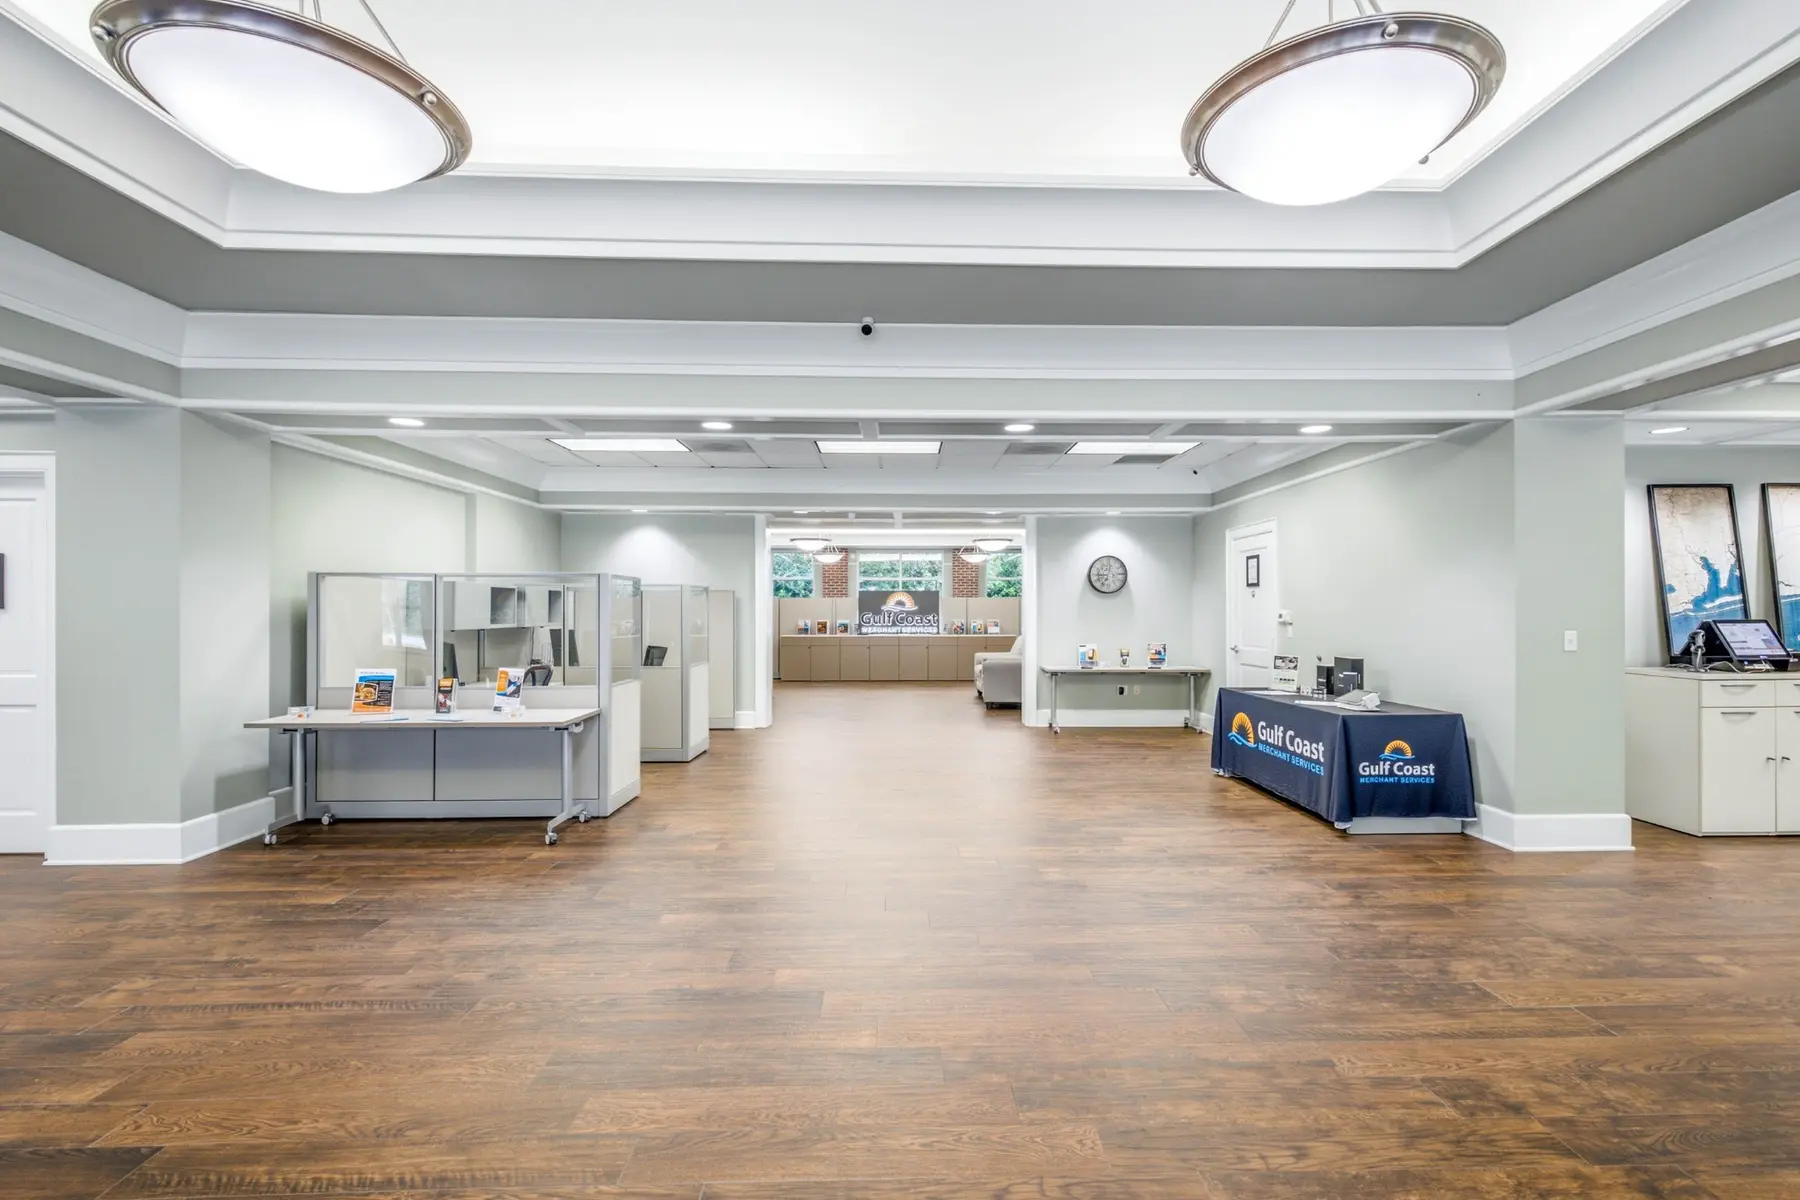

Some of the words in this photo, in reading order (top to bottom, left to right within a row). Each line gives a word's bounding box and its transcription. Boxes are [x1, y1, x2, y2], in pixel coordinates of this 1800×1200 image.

[860, 611, 894, 626] Gulf
[895, 611, 938, 626] Coast
[1257, 720, 1284, 747] Gulf
[1286, 730, 1325, 763] Coast
[1258, 742, 1290, 762] MERCHANT
[1291, 755, 1324, 776] SERVICES
[1358, 761, 1391, 776] Gulf
[1392, 761, 1435, 776] Coast
[1359, 776, 1399, 784] MERCHANT
[1400, 776, 1435, 784] SERVICES
